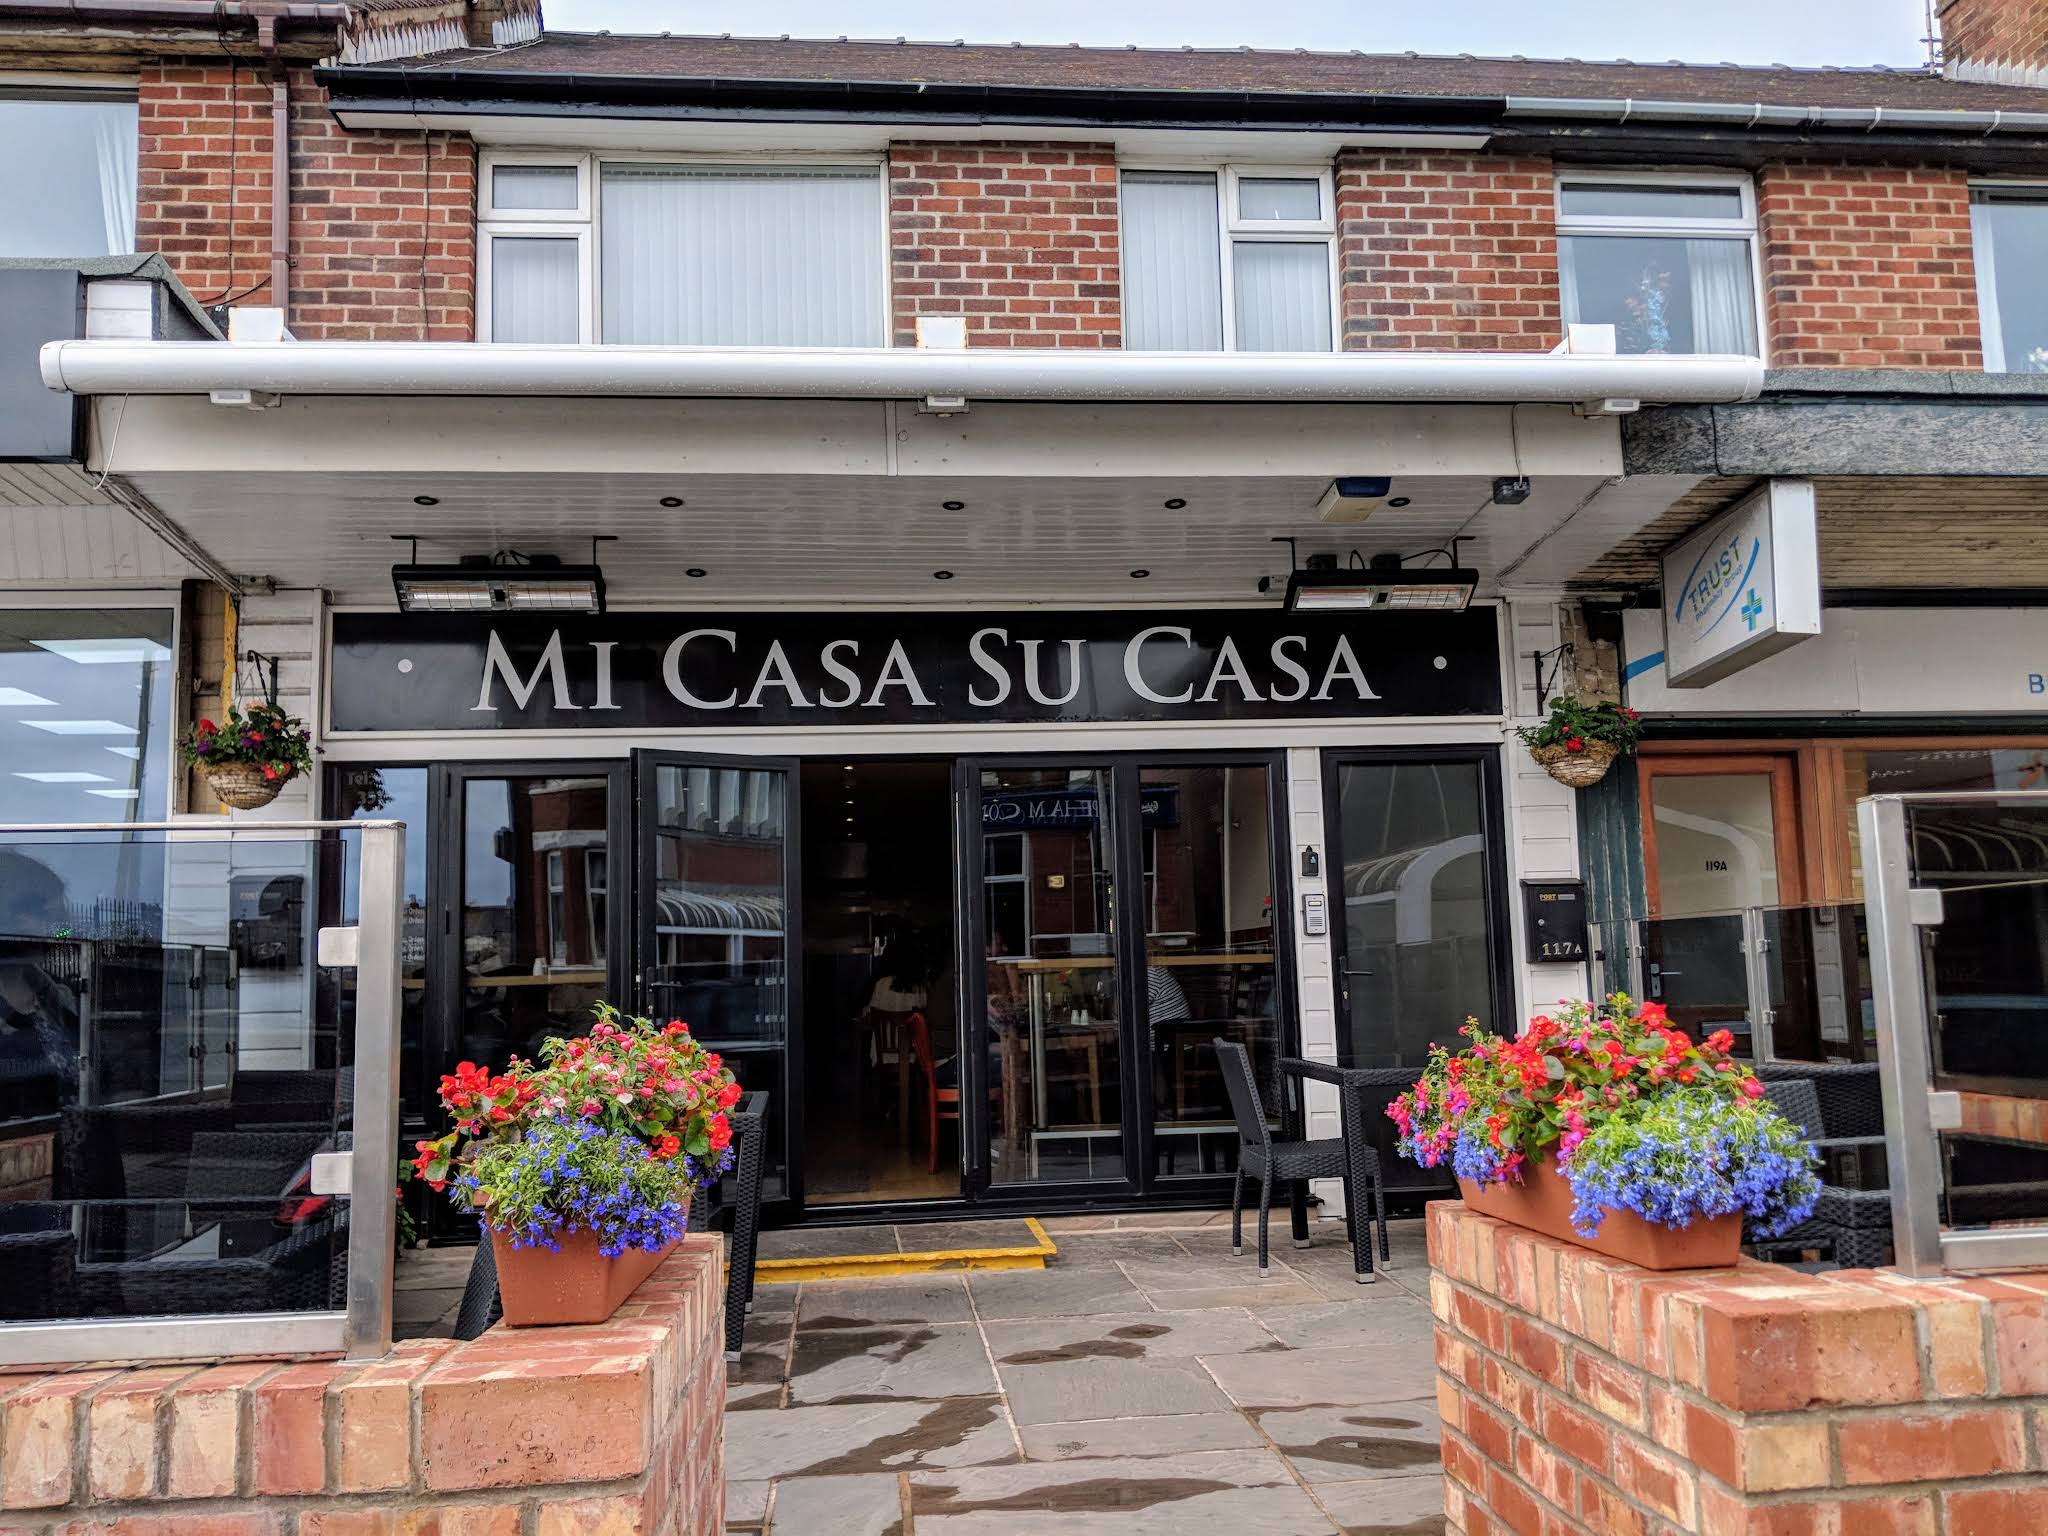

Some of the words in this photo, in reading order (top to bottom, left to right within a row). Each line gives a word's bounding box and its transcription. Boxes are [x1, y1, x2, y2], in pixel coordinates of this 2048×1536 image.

[1687, 535, 1740, 612] TRUST
[470, 628, 622, 712] MI
[663, 628, 936, 710] CASA
[968, 627, 1087, 708] SU
[1123, 626, 1382, 705] CASA
[1705, 860, 1728, 872] 119A
[1539, 893, 1557, 901] POST
[1542, 942, 1583, 956] 117A
